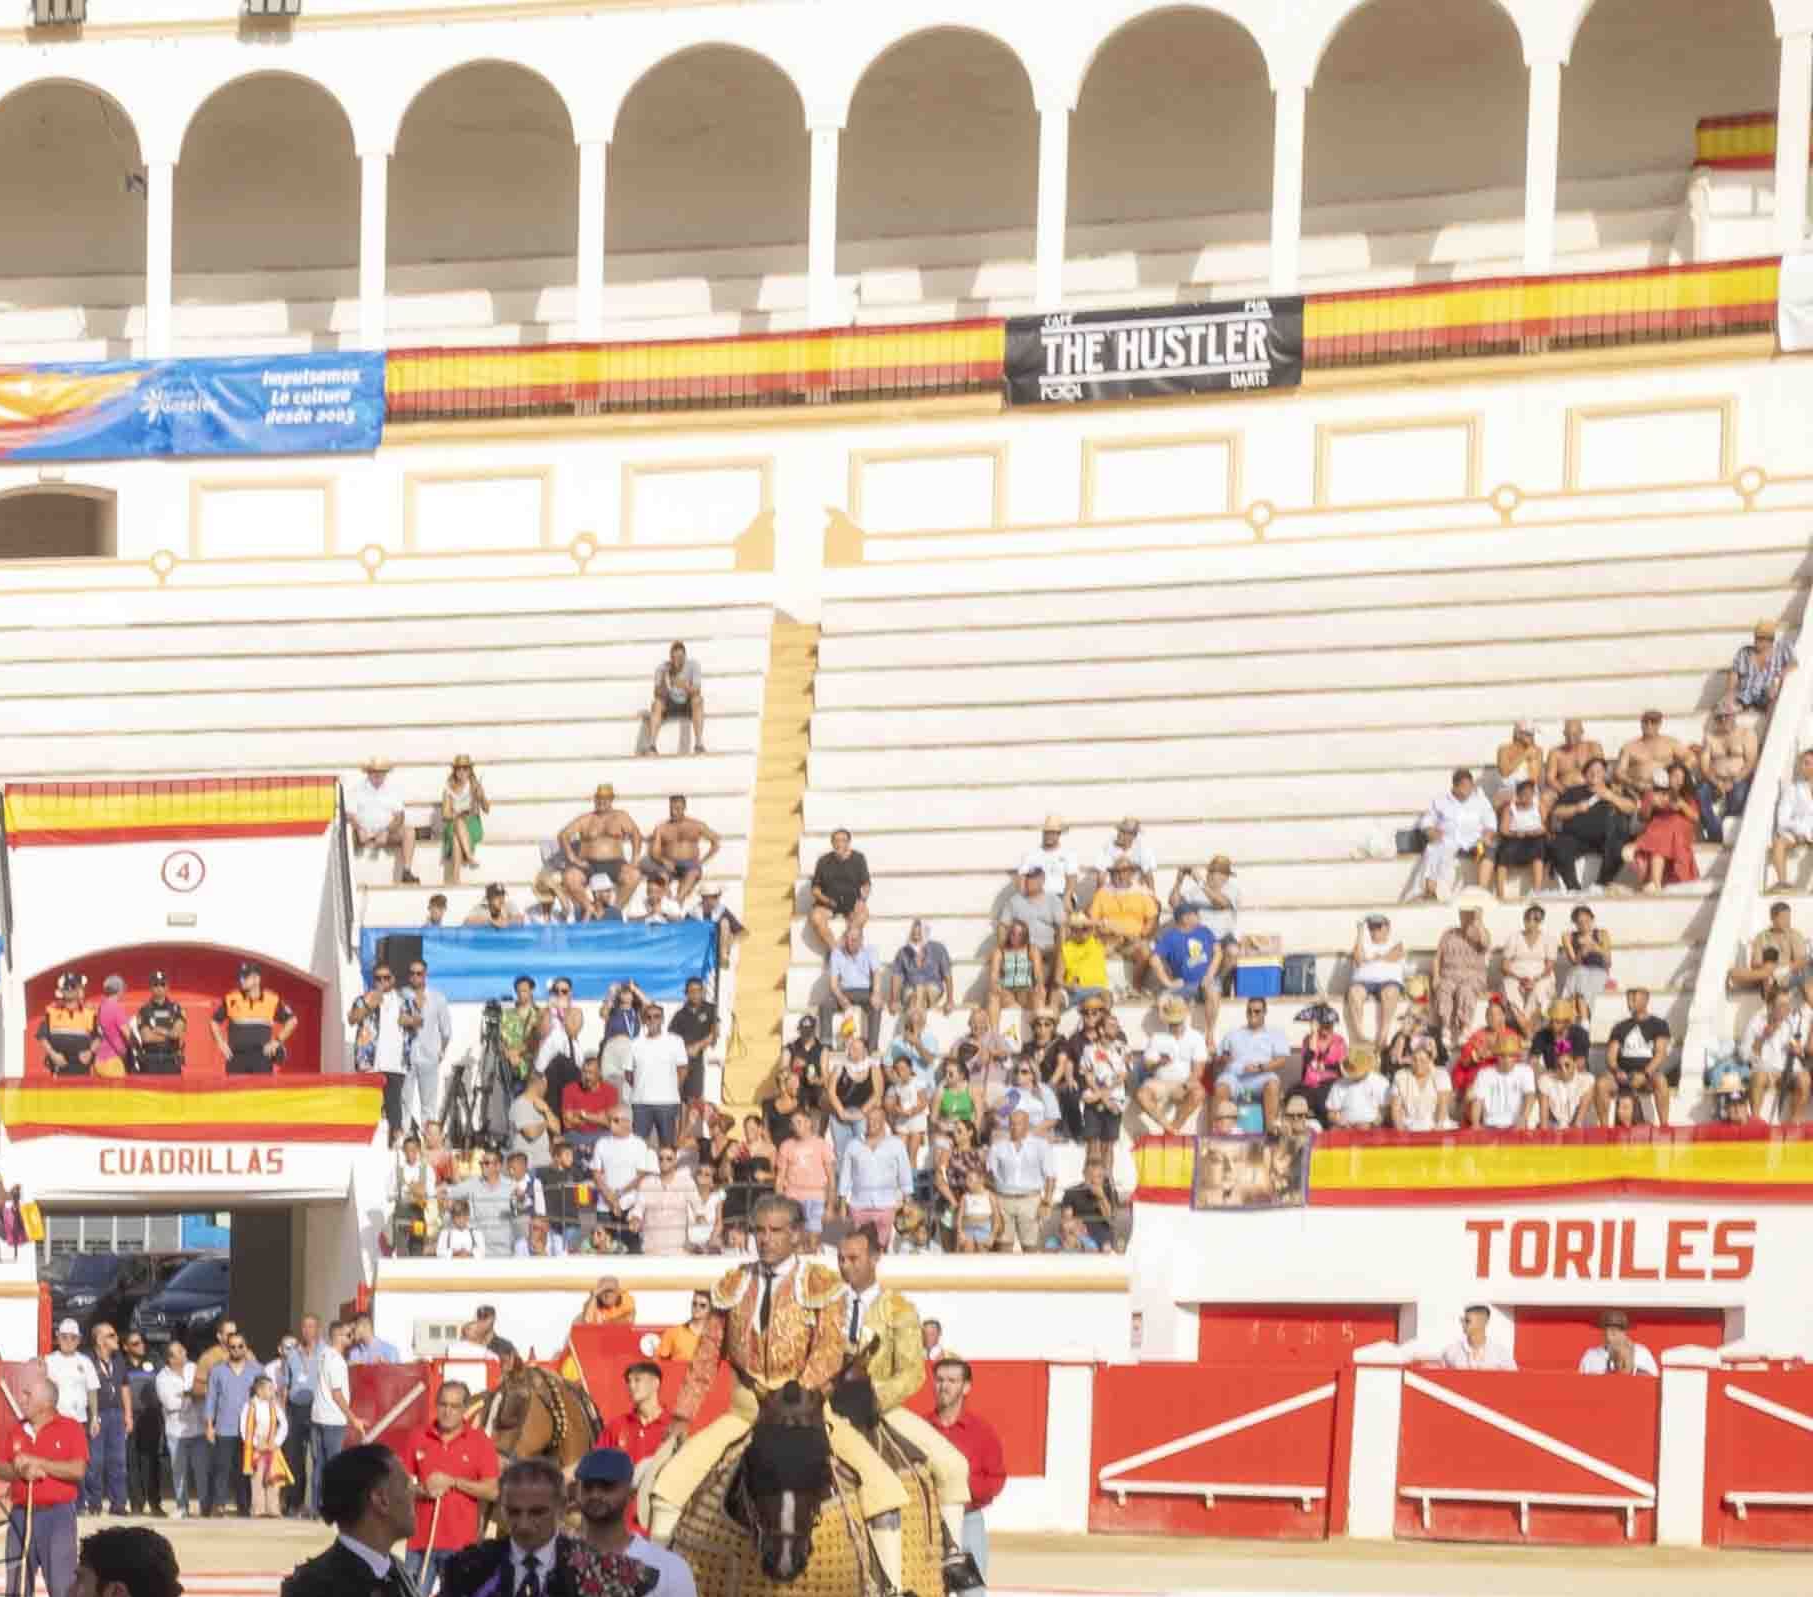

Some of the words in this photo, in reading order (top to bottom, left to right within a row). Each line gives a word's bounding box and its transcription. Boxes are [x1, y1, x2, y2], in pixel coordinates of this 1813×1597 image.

[1041, 331, 1105, 375] THE
[1117, 319, 1269, 371] HUSTLER
[261, 368, 361, 387] Impulsamos
[1230, 371, 1269, 389] DARTS
[294, 387, 352, 405] cultura
[264, 408, 313, 425] desde
[175, 861, 191, 882] 4
[99, 1147, 284, 1176] CUADRILLAS
[1465, 1219, 1757, 1281] TORILES
